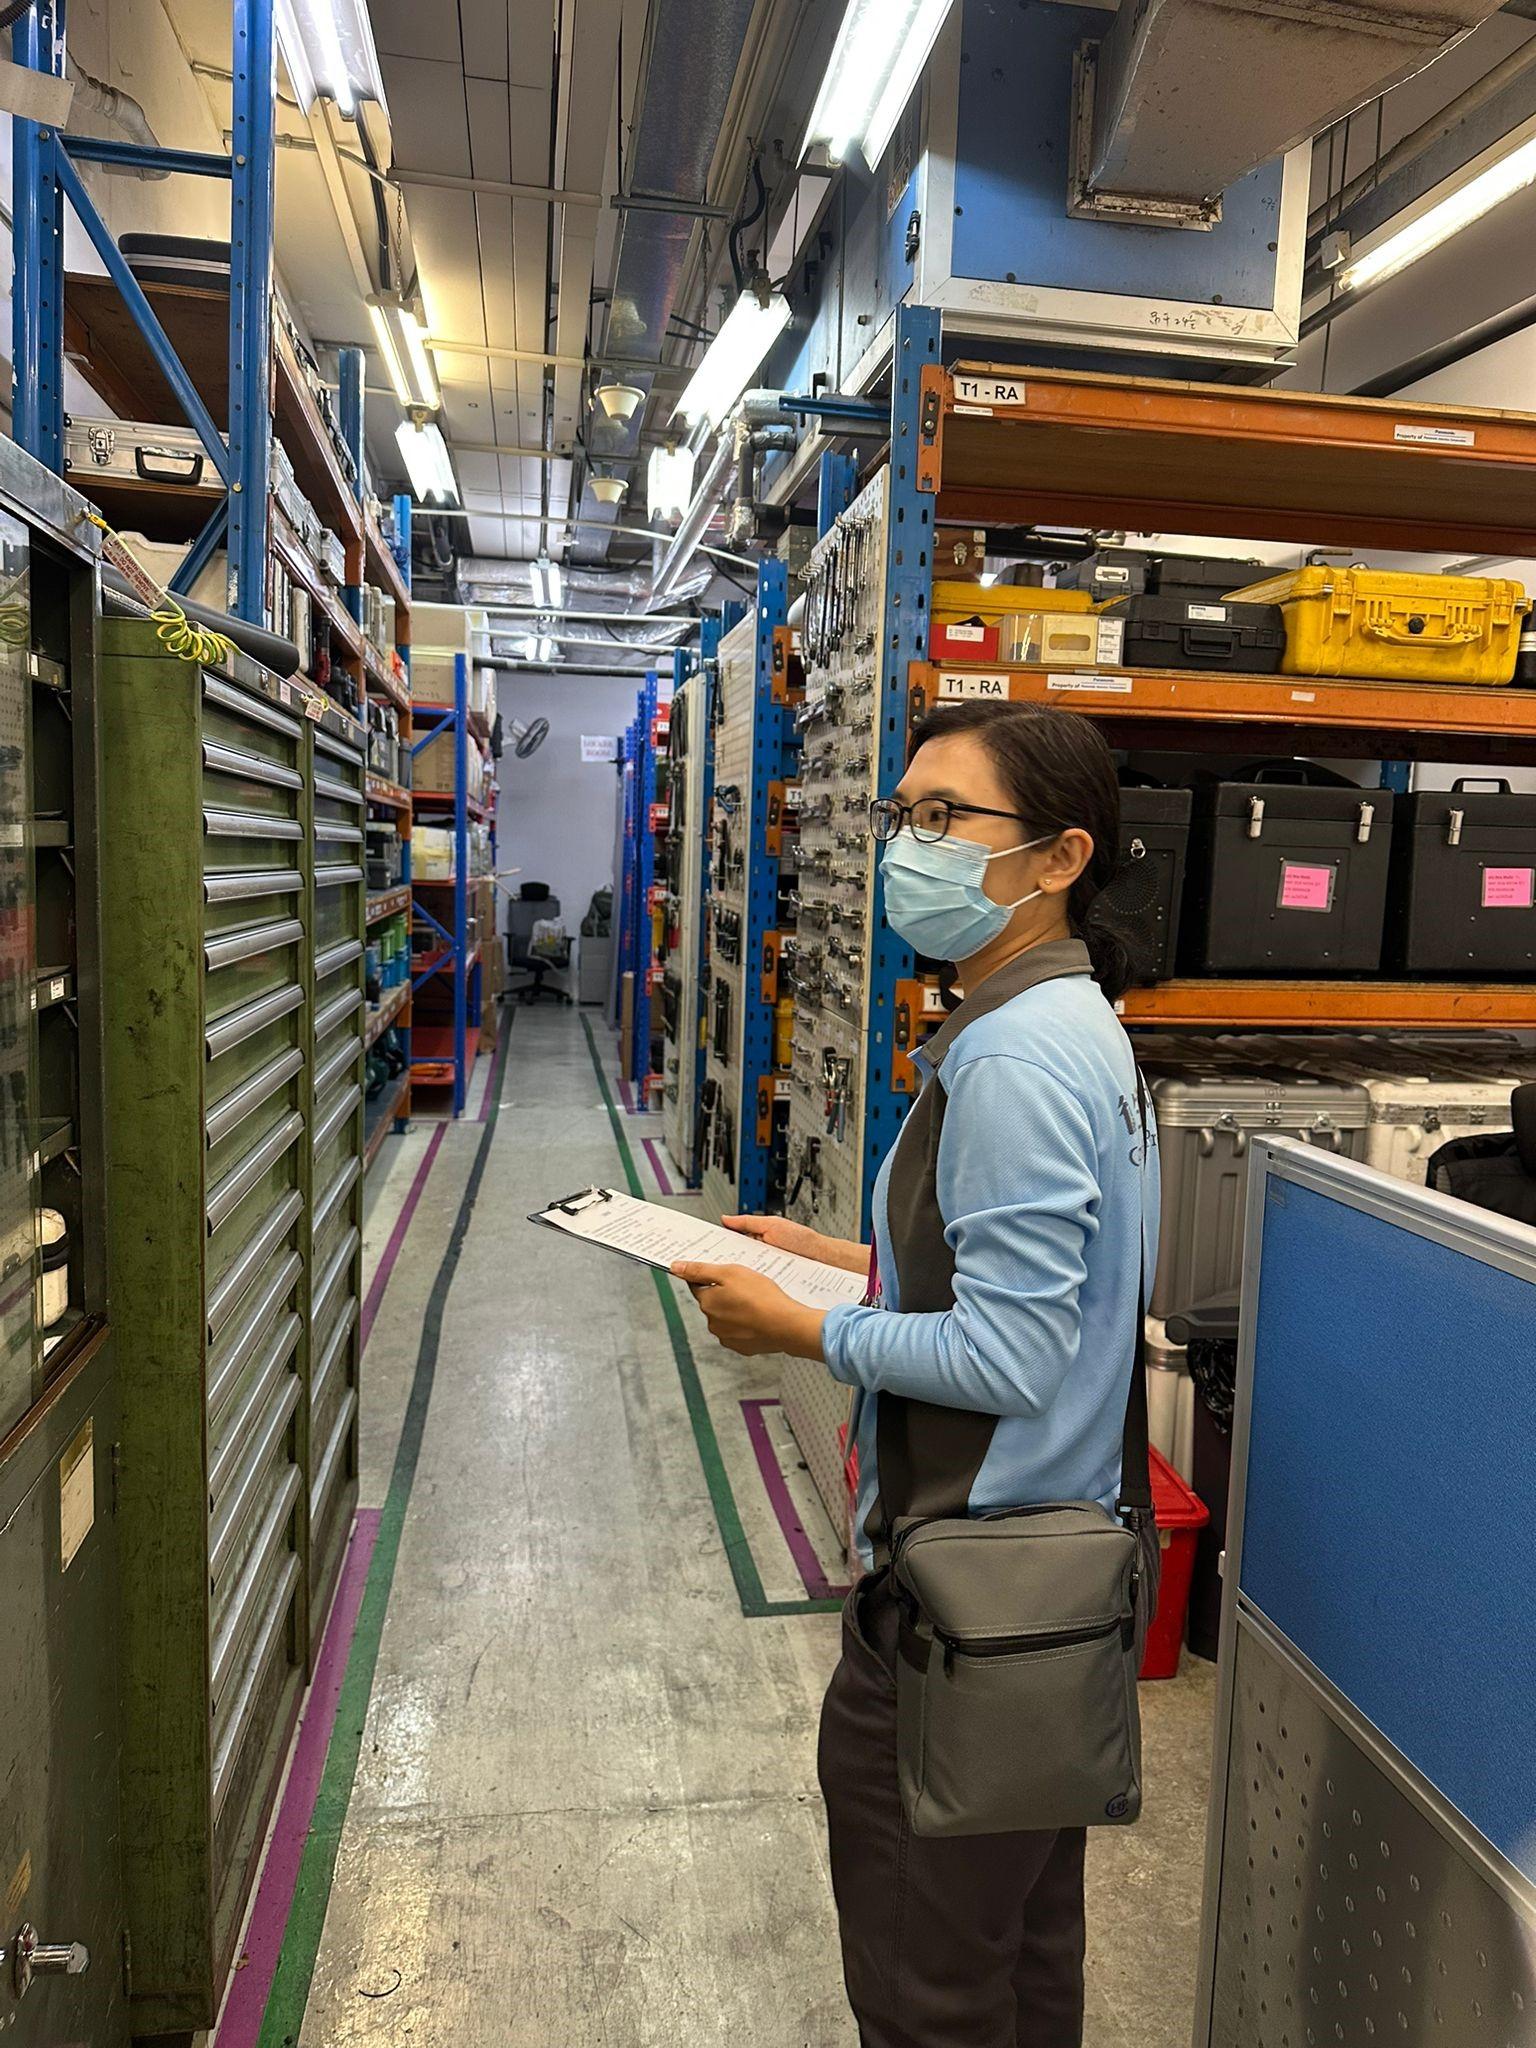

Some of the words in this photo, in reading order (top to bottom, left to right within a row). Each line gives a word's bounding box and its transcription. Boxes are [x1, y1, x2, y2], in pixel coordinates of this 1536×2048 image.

[960, 381, 978, 397] T1
[995, 385, 1018, 400] RA
[946, 679, 963, 692] T1
[980, 681, 1002, 694] RA
